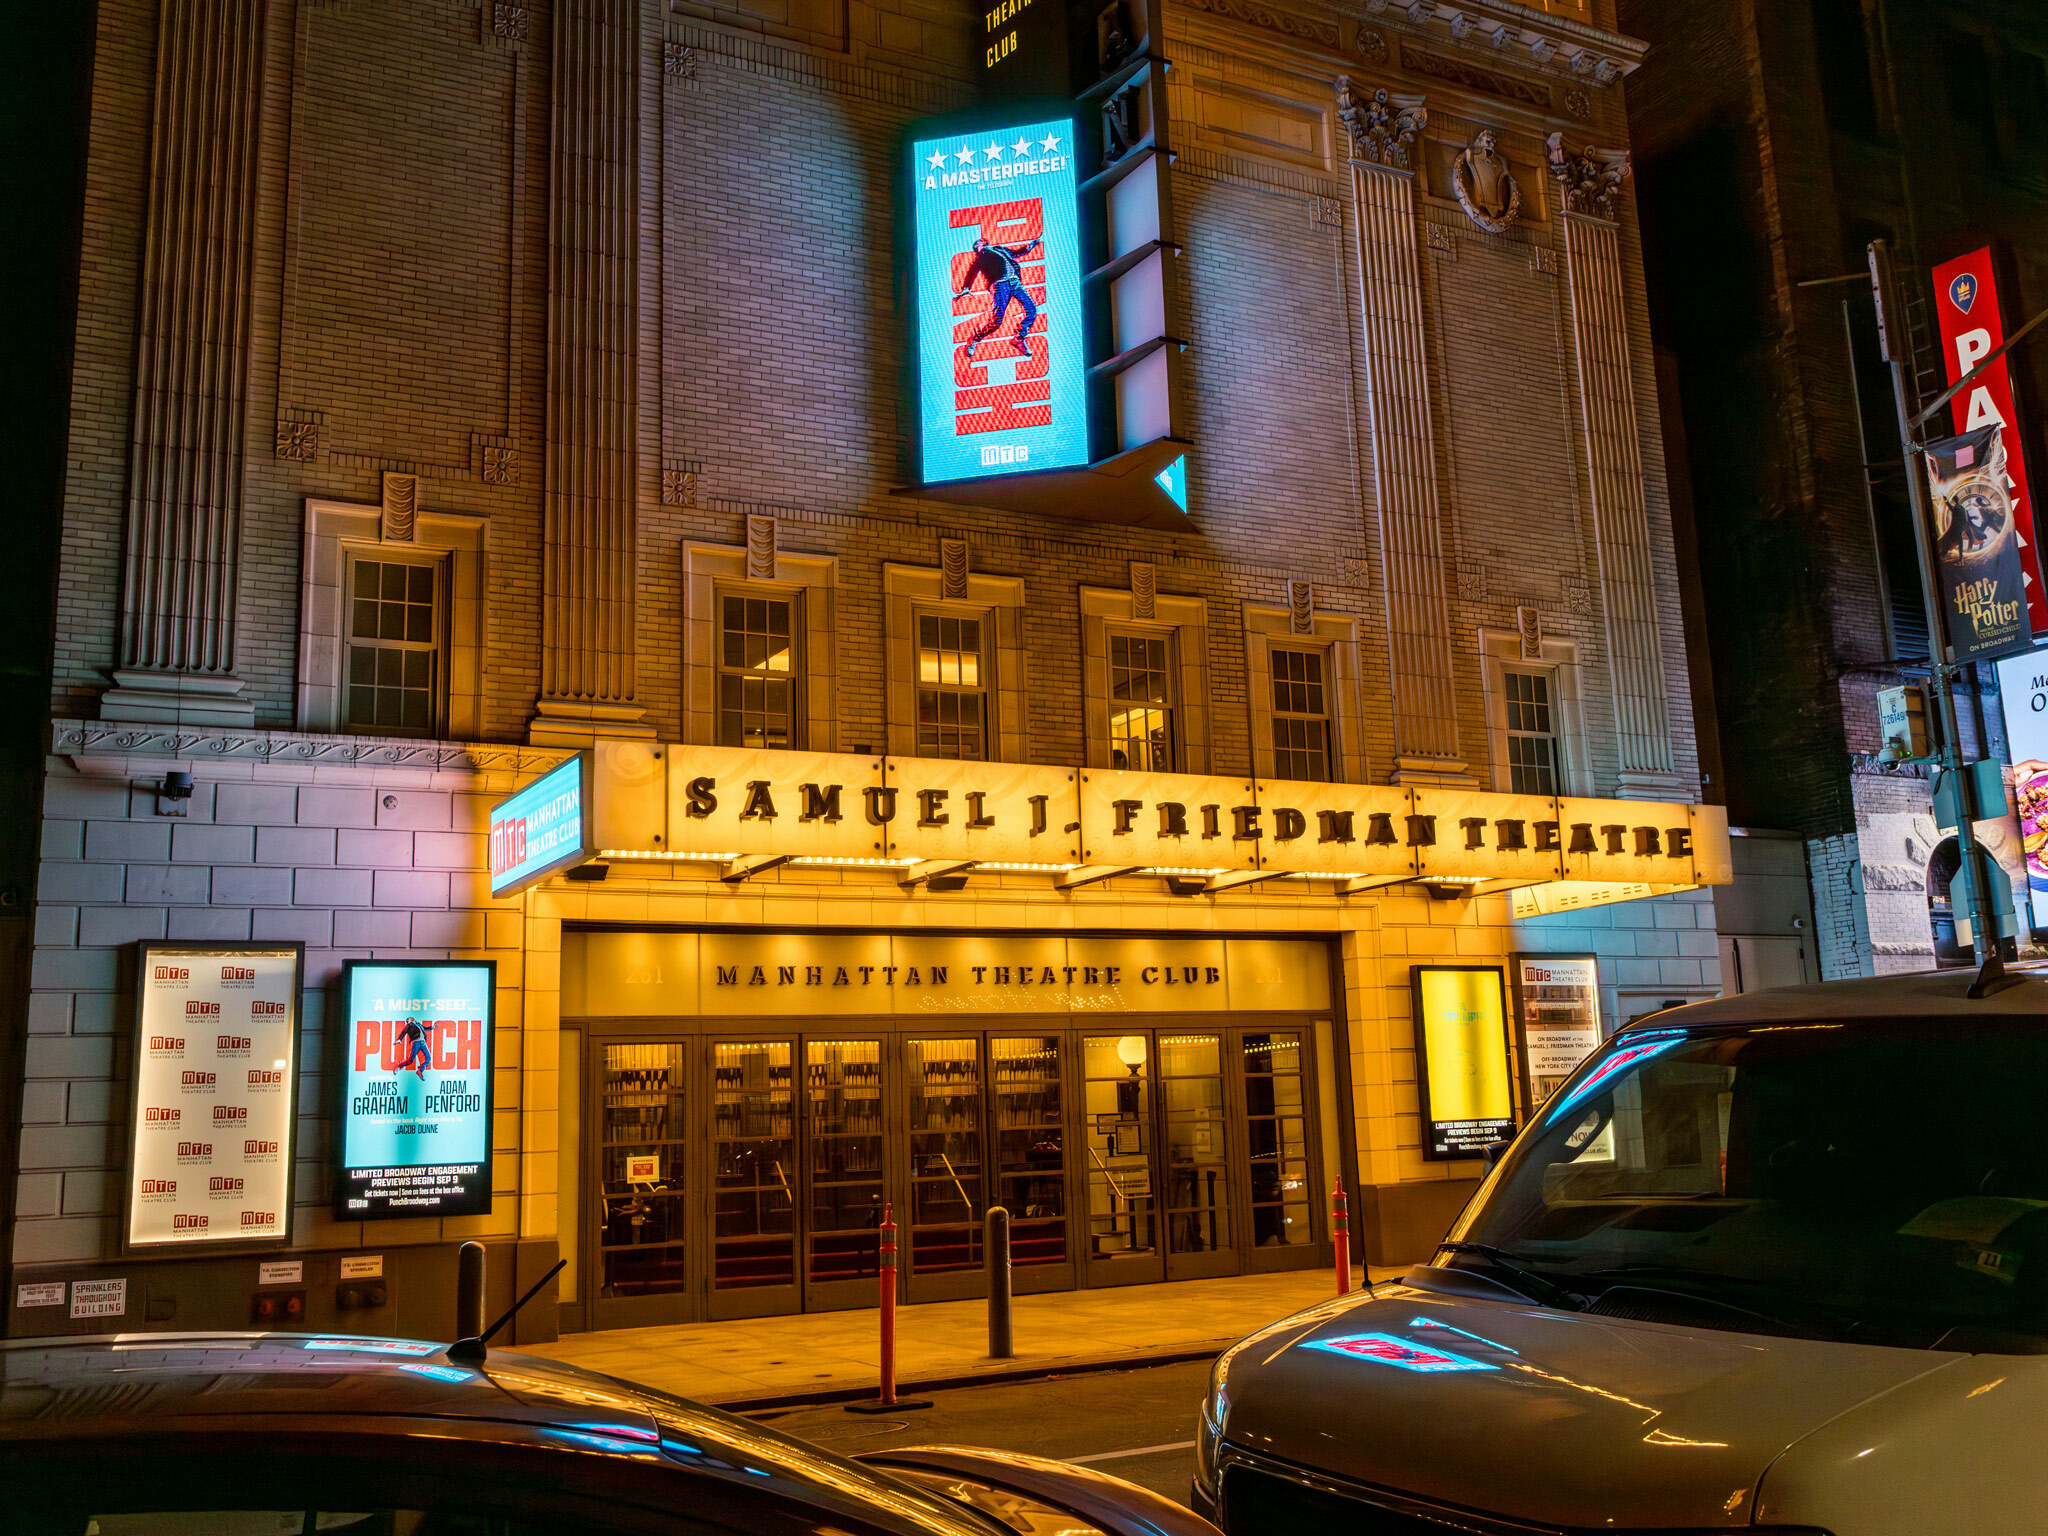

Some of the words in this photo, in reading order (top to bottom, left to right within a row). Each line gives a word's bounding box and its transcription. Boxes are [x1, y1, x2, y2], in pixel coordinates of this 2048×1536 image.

[986, 30, 1017, 68] CLUB
[942, 156, 1070, 188] MASTERPIECE!"
[949, 197, 1052, 436] PUNCH
[981, 445, 1029, 466] MTC
[1954, 577, 1998, 614] Harry
[1970, 600, 2019, 637] Potter
[1979, 629, 2002, 639] CURSED
[1981, 635, 2015, 649] BROADWAY
[1891, 704, 1897, 713] C
[526, 786, 579, 835] MANHATTAN
[685, 776, 995, 831] SAMUEL
[1027, 794, 1081, 838] J.
[1112, 799, 1437, 847] FRIEDMAN
[1459, 817, 1694, 858] THEATRE
[527, 828, 557, 860] THEATRE
[559, 817, 579, 841] CLUB
[492, 817, 527, 878] MTC
[155, 966, 189, 979] MTC
[221, 967, 255, 979] MTC
[716, 965, 949, 986] MANHATTAN
[972, 966, 1121, 985] THEATRE
[1141, 966, 1220, 985] CLUB
[1525, 967, 1551, 981] MTC
[186, 1001, 220, 1014] MTC
[252, 1001, 285, 1014] MTC
[389, 998, 470, 1011] MUST-SEE!"
[150, 1037, 184, 1049] MTC
[217, 1036, 251, 1048] MTC
[355, 1020, 481, 1071] PUNCH
[182, 1071, 216, 1084] MTC
[248, 1070, 281, 1083] MTC
[365, 1082, 397, 1096] JAMES
[440, 1081, 466, 1094] ADAM
[353, 1096, 408, 1115] GRAHAM
[425, 1095, 480, 1113] PENFORD
[146, 1108, 180, 1121] MTC
[213, 1106, 247, 1119] MTC
[395, 1125, 415, 1134] JACOB
[418, 1124, 438, 1134] DUNNE
[178, 1142, 212, 1155] MTC
[244, 1140, 278, 1153] MTC
[352, 1170, 382, 1179] LIMITED
[384, 1168, 426, 1177] BROADWAY
[428, 1165, 478, 1175] ENGAGEMENT
[142, 1180, 176, 1193] MTC
[210, 1177, 243, 1190] MTC
[372, 1177, 410, 1187] PREVIEWS
[413, 1176, 434, 1185] BEGIN
[437, 1175, 451, 1184] SEP
[453, 1175, 458, 1184] 9
[373, 1189, 388, 1197] tickets
[389, 1197, 440, 1206] PunchBroadway.com
[174, 1214, 208, 1228] MTC
[241, 1212, 275, 1225] MTC
[76, 1283, 121, 1293] SPRINKLERS
[75, 1293, 121, 1303] THROUGHOUT
[75, 1303, 120, 1314] BUILDING
